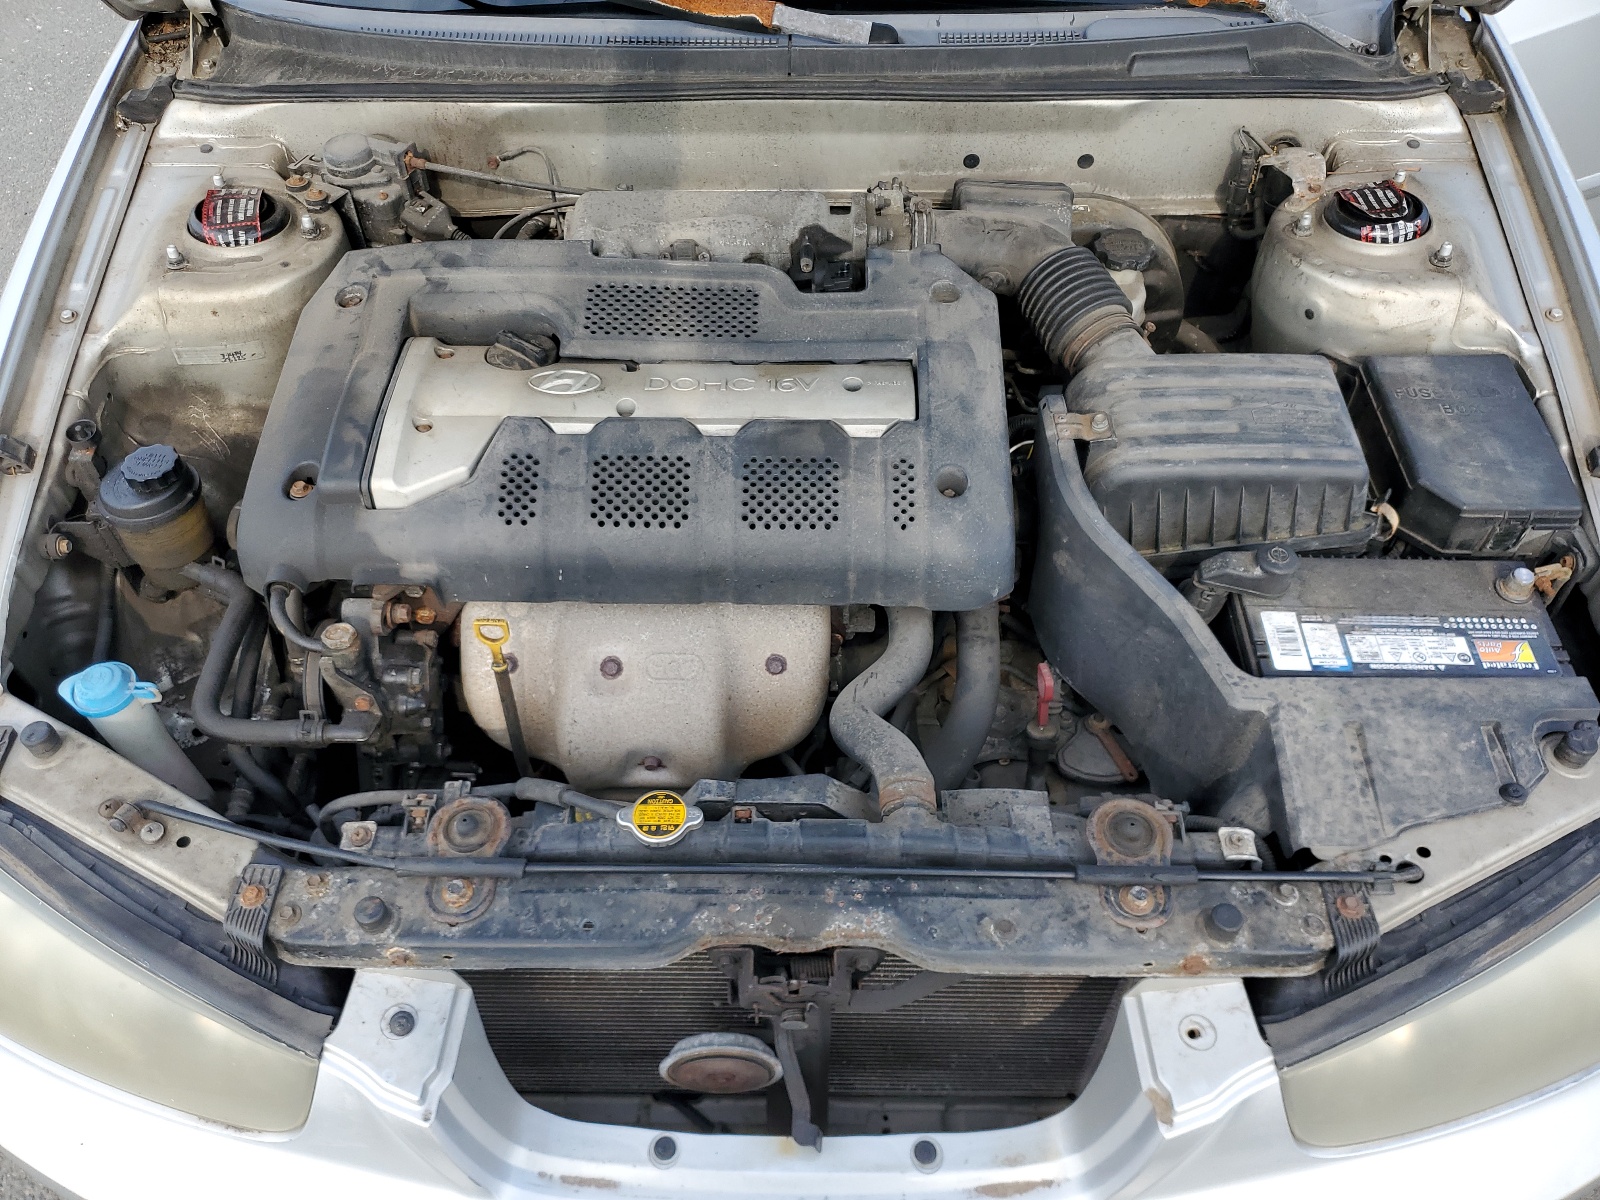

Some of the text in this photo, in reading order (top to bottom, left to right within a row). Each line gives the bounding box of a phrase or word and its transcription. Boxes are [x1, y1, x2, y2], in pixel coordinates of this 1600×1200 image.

[644, 377, 820, 392] DOHC 16V
[1394, 386, 1444, 400] FUSE
[1482, 661, 1540, 671] Federated
